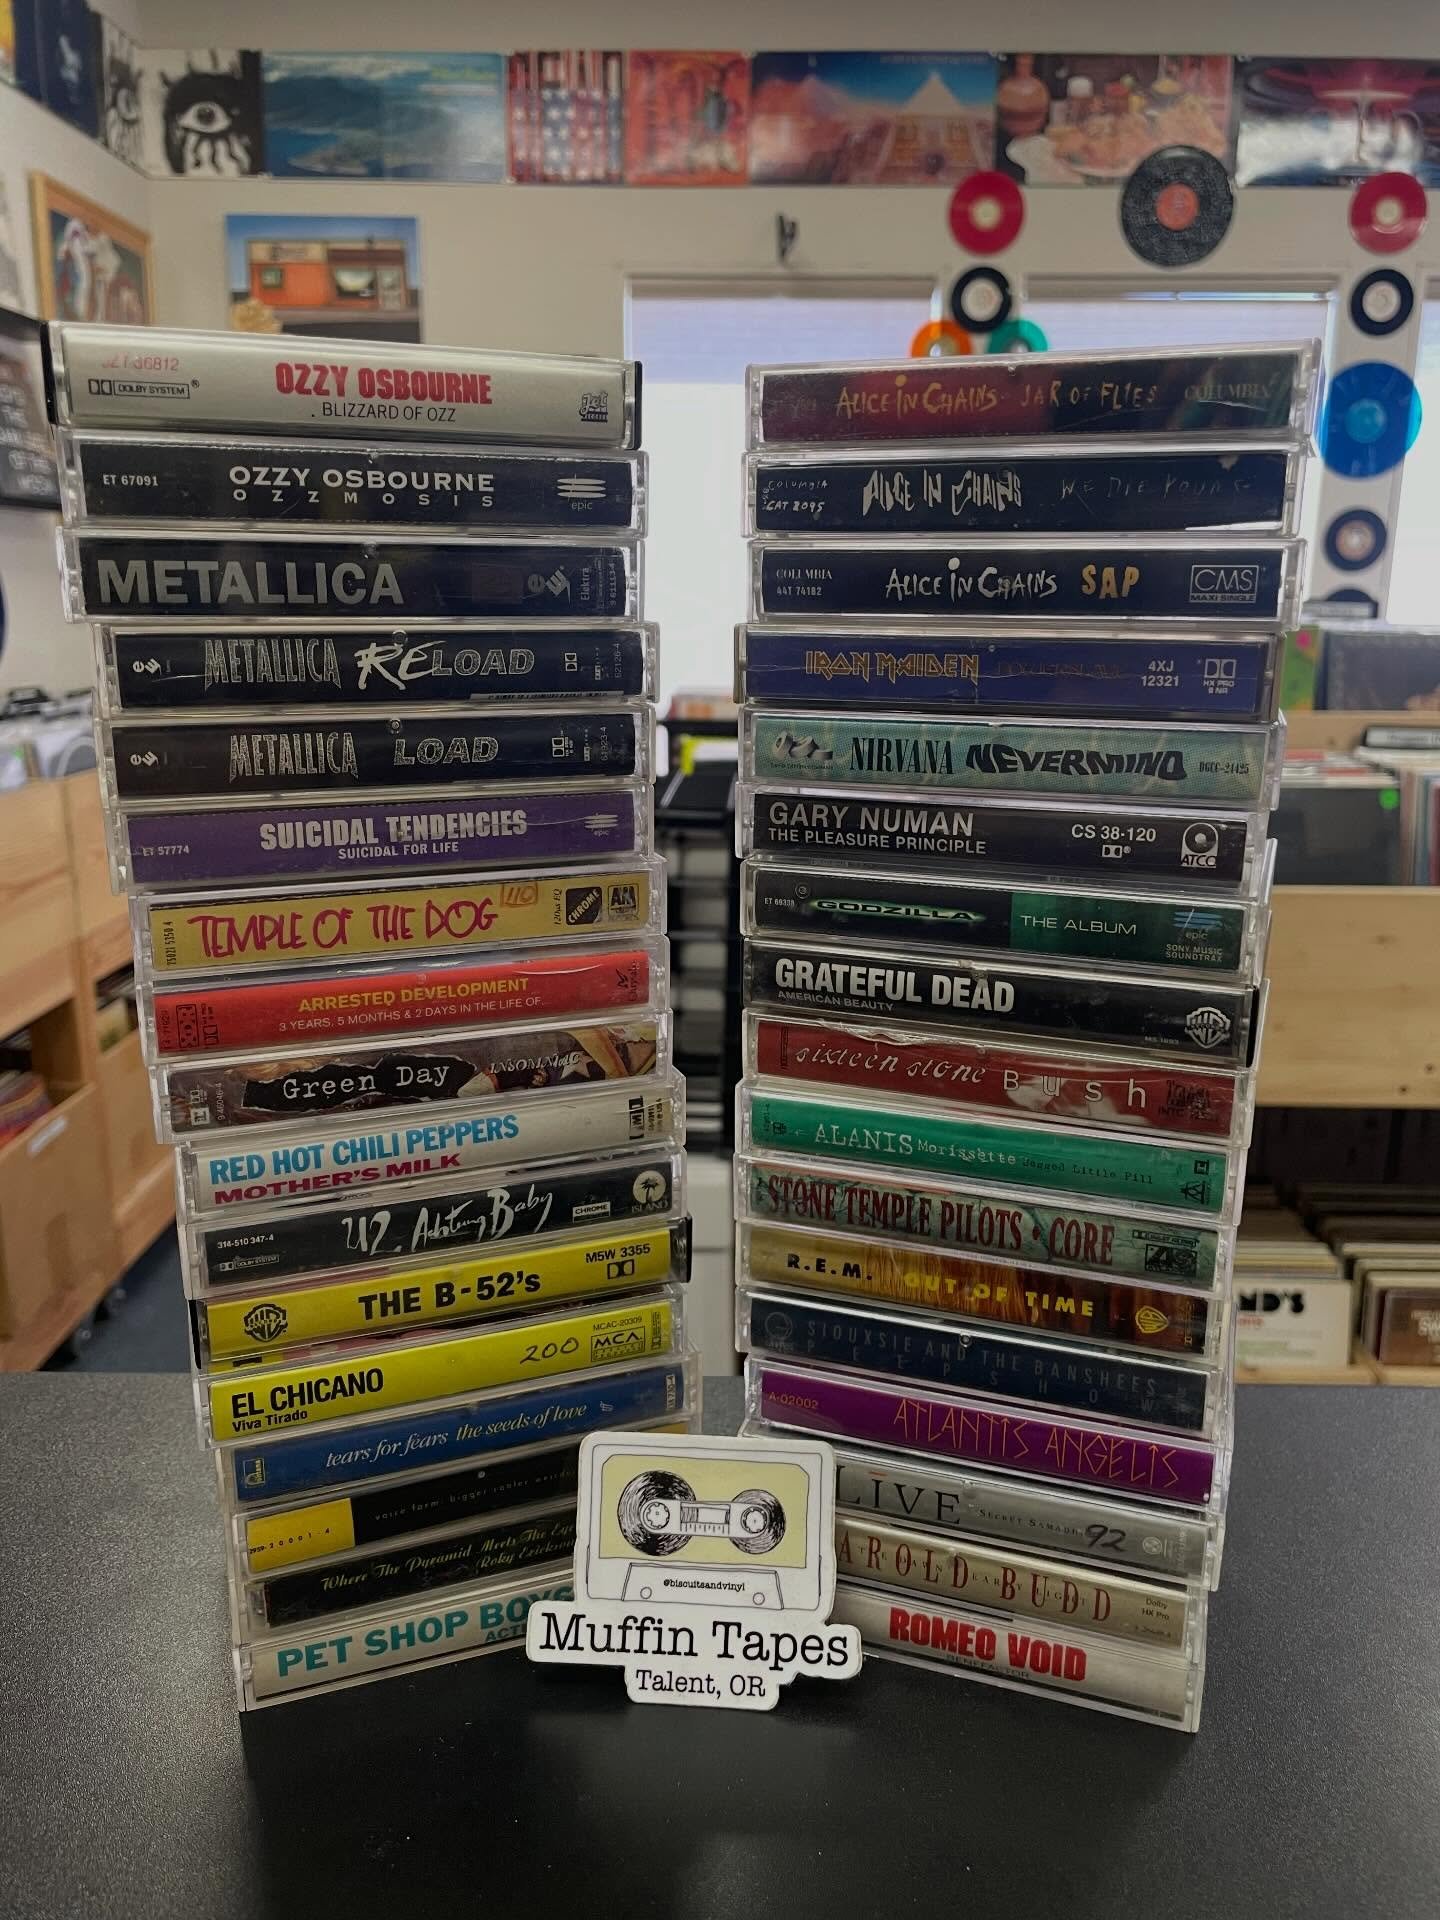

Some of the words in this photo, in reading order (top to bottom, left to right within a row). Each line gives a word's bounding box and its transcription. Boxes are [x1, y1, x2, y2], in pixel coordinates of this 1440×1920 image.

[149, 385, 185, 396] SYSTEM
[275, 361, 348, 397] OZZY
[358, 366, 493, 405] OSBOURNE
[836, 386, 890, 420] ALICE
[922, 382, 998, 414] CHAINS
[1020, 380, 1062, 408] JAR
[322, 401, 399, 420] BLIZZARD
[402, 405, 423, 421] OF
[427, 407, 456, 423] OZZ
[102, 474, 117, 486] ET
[121, 475, 159, 488] 67091
[229, 465, 311, 487] OZZY
[322, 468, 494, 492] OSBOURNE
[862, 469, 915, 517] ALICE
[923, 468, 942, 508] IN
[951, 469, 1023, 516] CHAINS
[570, 501, 593, 511] epic
[97, 558, 405, 605] METALLICA
[776, 568, 833, 580] COLUMBIA
[886, 568, 942, 601] ALICE
[977, 566, 1058, 600] CHAINS
[1081, 564, 1140, 599] SAP
[1194, 568, 1253, 592] CMS
[204, 638, 341, 692] METALLICA
[805, 650, 870, 683] IRON
[876, 652, 980, 686] MAIDEN
[1147, 659, 1174, 673] 4XJ
[1140, 674, 1180, 688] 12321
[229, 731, 359, 784] METALLICA
[393, 736, 499, 766] LOAD
[850, 736, 955, 775] NIRVANA
[966, 743, 1188, 781] NEVERMIND
[259, 817, 379, 851] SUICIDAL
[386, 809, 528, 843] TENDENCIES
[769, 801, 850, 829] GARY
[860, 807, 975, 837] NUMAN
[1071, 824, 1096, 839] CS
[338, 845, 399, 860] SUICIDAL
[403, 843, 428, 856] FOR
[432, 841, 459, 854] LIFE
[768, 827, 799, 843] THE
[804, 831, 890, 848] PLEASURE
[896, 836, 987, 855] PRINCIPLE
[1181, 855, 1217, 868] ATCO
[568, 888, 600, 924] CHROME
[764, 896, 773, 907] ET
[816, 899, 975, 921] GODZILLA
[1020, 915, 1058, 930] THE
[1064, 918, 1137, 936] ALBUM
[187, 911, 308, 958] TEMPLE
[312, 907, 353, 949] OF
[366, 904, 416, 943] THE
[425, 897, 499, 939] DOG
[1166, 943, 1191, 953] SONY
[298, 990, 396, 1013] ARRESTED
[401, 977, 530, 1002] DEVELOPMENT
[775, 957, 922, 1003] GRATEFUL
[931, 974, 1015, 1013] DEAD
[777, 990, 841, 1006] AMERICAN
[844, 996, 894, 1012] BEAUTY
[278, 1022, 286, 1032] 3
[337, 1016, 345, 1026] 5
[349, 1011, 401, 1025] MONTHS
[404, 1009, 411, 1018] &
[415, 1008, 422, 1018] 2
[425, 1005, 457, 1017] DAYS
[460, 1003, 471, 1014] IN
[474, 1001, 498, 1012] THE
[500, 999, 522, 1010] LIFE
[795, 1041, 900, 1073] sixteen
[905, 1058, 986, 1084] stone
[283, 1073, 377, 1100] Green
[396, 1065, 450, 1088] Day
[209, 1153, 265, 1185] RED
[271, 1143, 325, 1176] HOT
[332, 1131, 401, 1166] CHILI
[405, 1115, 519, 1155] PEPPERS
[815, 1123, 913, 1155] ALANIS
[917, 1138, 1017, 1166] Morissette
[1124, 1171, 1153, 1185] Pill
[214, 1166, 381, 1205] MOTHER'S
[385, 1152, 461, 1178] MILK
[485, 1183, 553, 1241] Baby
[574, 1204, 609, 1217] CHROME
[631, 1200, 670, 1214] ISLAND
[768, 1174, 838, 1221] STONE
[844, 1184, 932, 1237] TEMPLE
[940, 1199, 1023, 1250] PILOTS
[1050, 1216, 1116, 1266] CORE
[249, 1233, 274, 1245] 347-4
[585, 1249, 616, 1263] M5W
[620, 1243, 651, 1258] 3355
[787, 1253, 873, 1281] R.E.M.
[903, 1271, 957, 1295] OUT
[972, 1283, 1009, 1302] OF
[1025, 1290, 1094, 1317] TIME
[357, 1286, 421, 1321] THE
[520, 1337, 580, 1364] 200
[231, 1391, 264, 1419] EL
[270, 1367, 384, 1411] CHICANO
[232, 1418, 263, 1433] Viva
[264, 1409, 308, 1426] Tirado
[326, 1446, 371, 1468] tears
[368, 1439, 402, 1463] for
[398, 1431, 449, 1457] fears
[456, 1423, 483, 1442] the
[485, 1411, 533, 1436] seeds
[533, 1408, 551, 1429] of
[552, 1404, 588, 1420] love
[893, 1398, 1030, 1460] ATLANTIS
[1045, 1426, 1180, 1488] ANGELIS
[836, 1464, 960, 1525] LIVE
[1085, 1523, 1127, 1550] 92
[321, 1571, 368, 1592] Where
[374, 1563, 401, 1578] The
[405, 1545, 472, 1572] Pyramid
[476, 1534, 518, 1554] Meets
[837, 1529, 969, 1589] AROLD
[1000, 1566, 1111, 1622] BUDD
[1141, 1607, 1154, 1617] HX
[1145, 1597, 1168, 1610] Dolby
[277, 1635, 353, 1678] PET
[364, 1609, 469, 1657] SHOP
[538, 1612, 699, 1658] Muffin
[712, 1620, 850, 1673] Tapes
[889, 1606, 997, 1661] ROMEO
[1007, 1632, 1087, 1682] VOID
[635, 1669, 722, 1701] Talent,
[729, 1674, 766, 1698] OR
